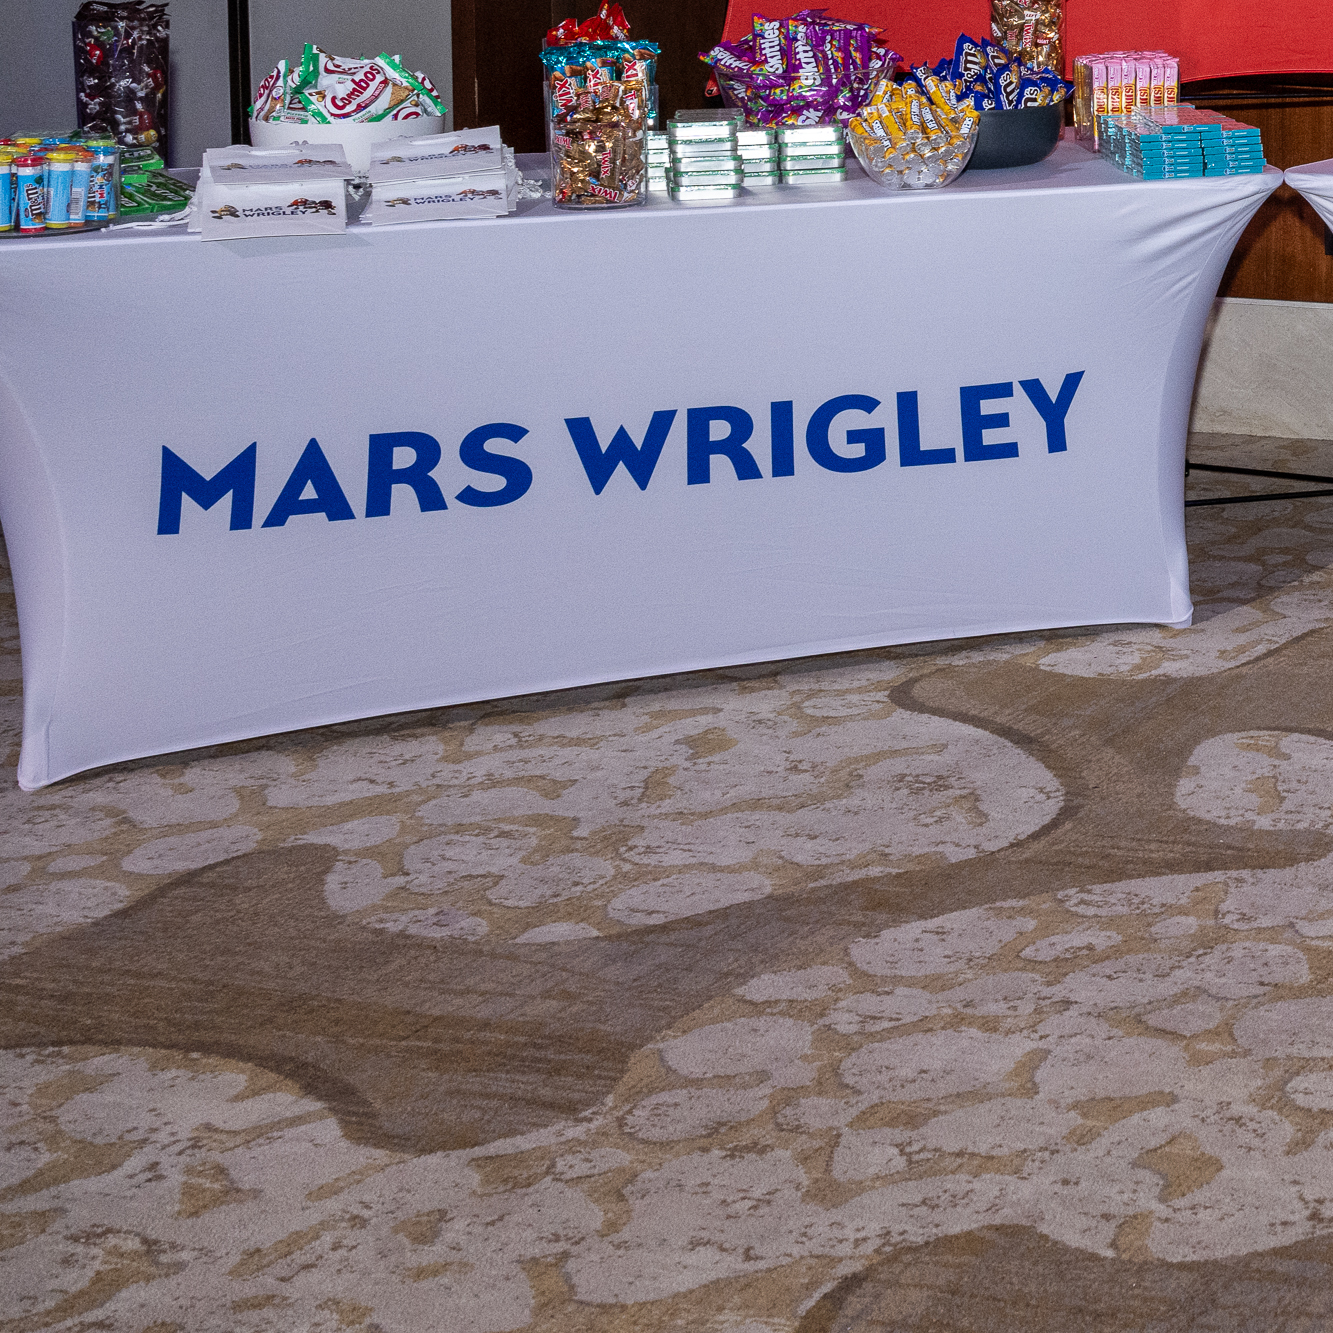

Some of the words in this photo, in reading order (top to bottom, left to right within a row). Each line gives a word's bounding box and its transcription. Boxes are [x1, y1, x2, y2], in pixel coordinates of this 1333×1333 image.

[759, 20, 783, 74] Skittles
[1023, 22, 1034, 48] TWIX
[330, 63, 382, 111] Combos
[601, 148, 613, 178] TWIX
[415, 196, 476, 205] WRIGLEY
[589, 185, 620, 202] TWIX
[243, 209, 308, 218] WRIGLEY
[157, 422, 533, 535] MARS
[564, 370, 1086, 497] WRIGLEY
